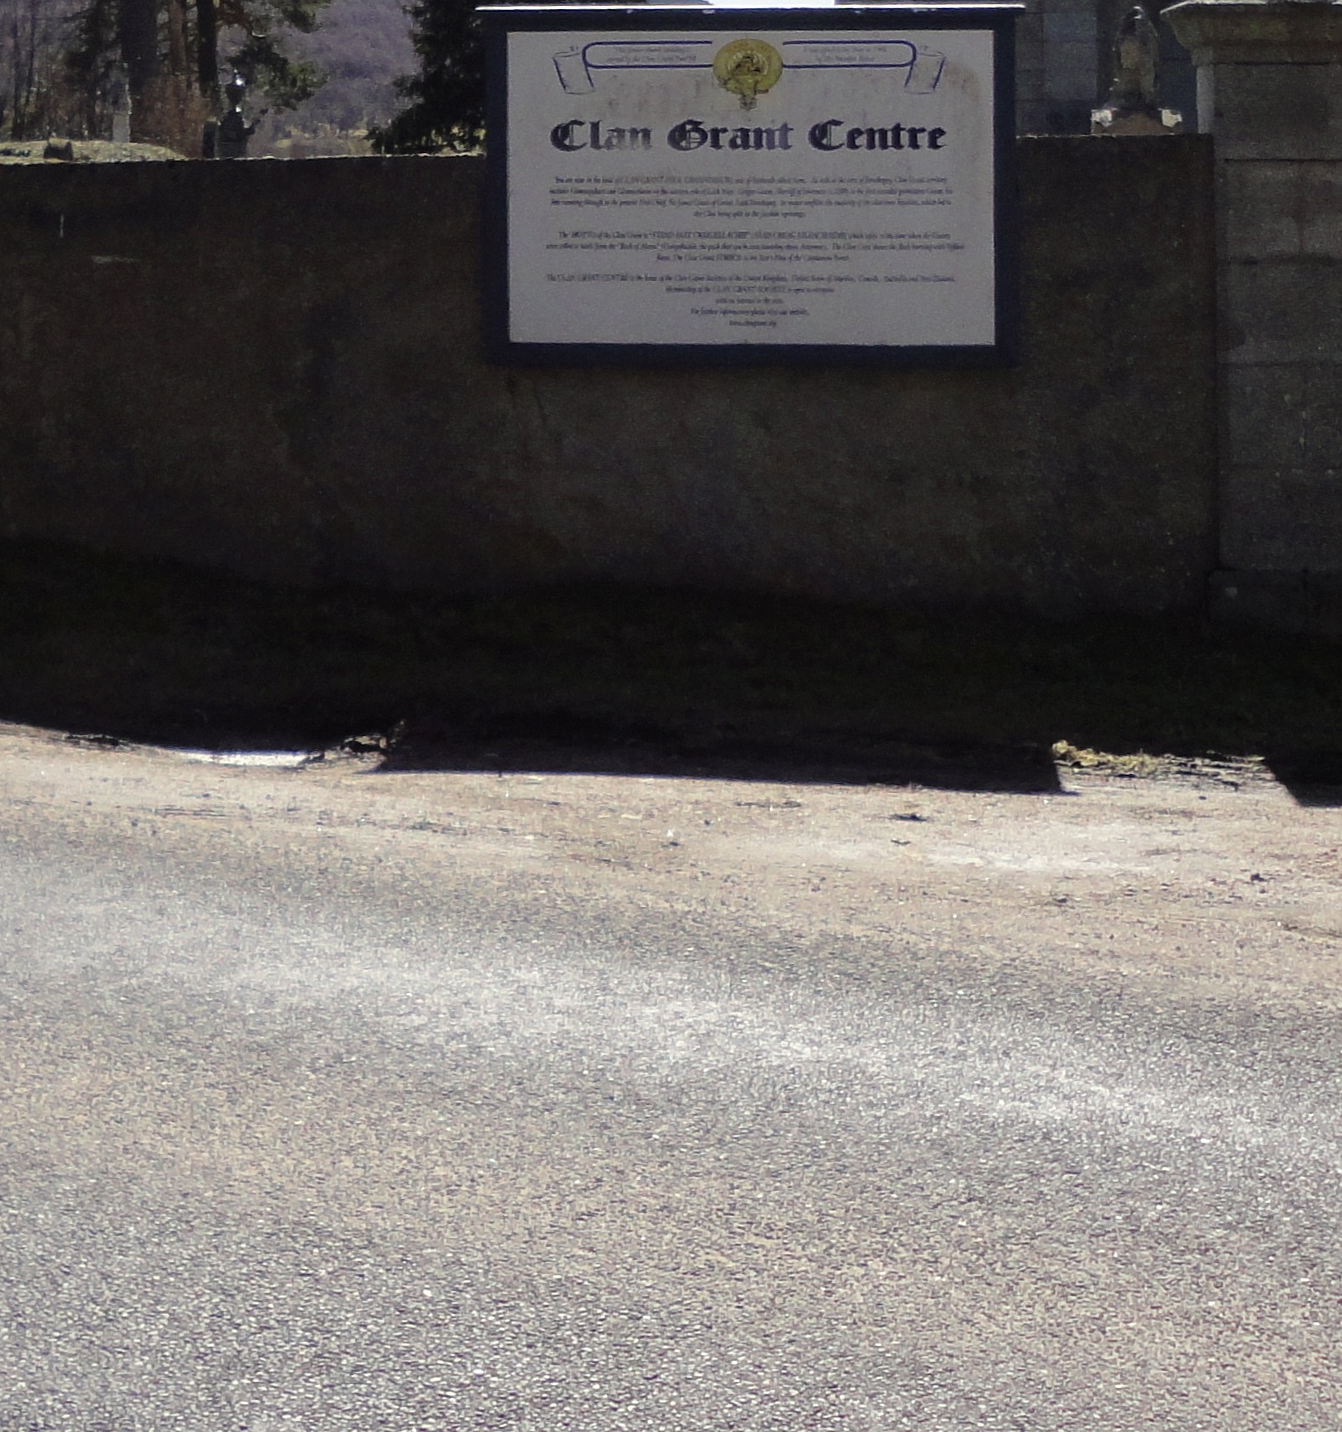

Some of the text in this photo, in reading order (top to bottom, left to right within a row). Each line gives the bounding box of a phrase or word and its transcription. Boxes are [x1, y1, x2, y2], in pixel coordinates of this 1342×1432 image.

[549, 119, 948, 152] Clan Grant Centre
